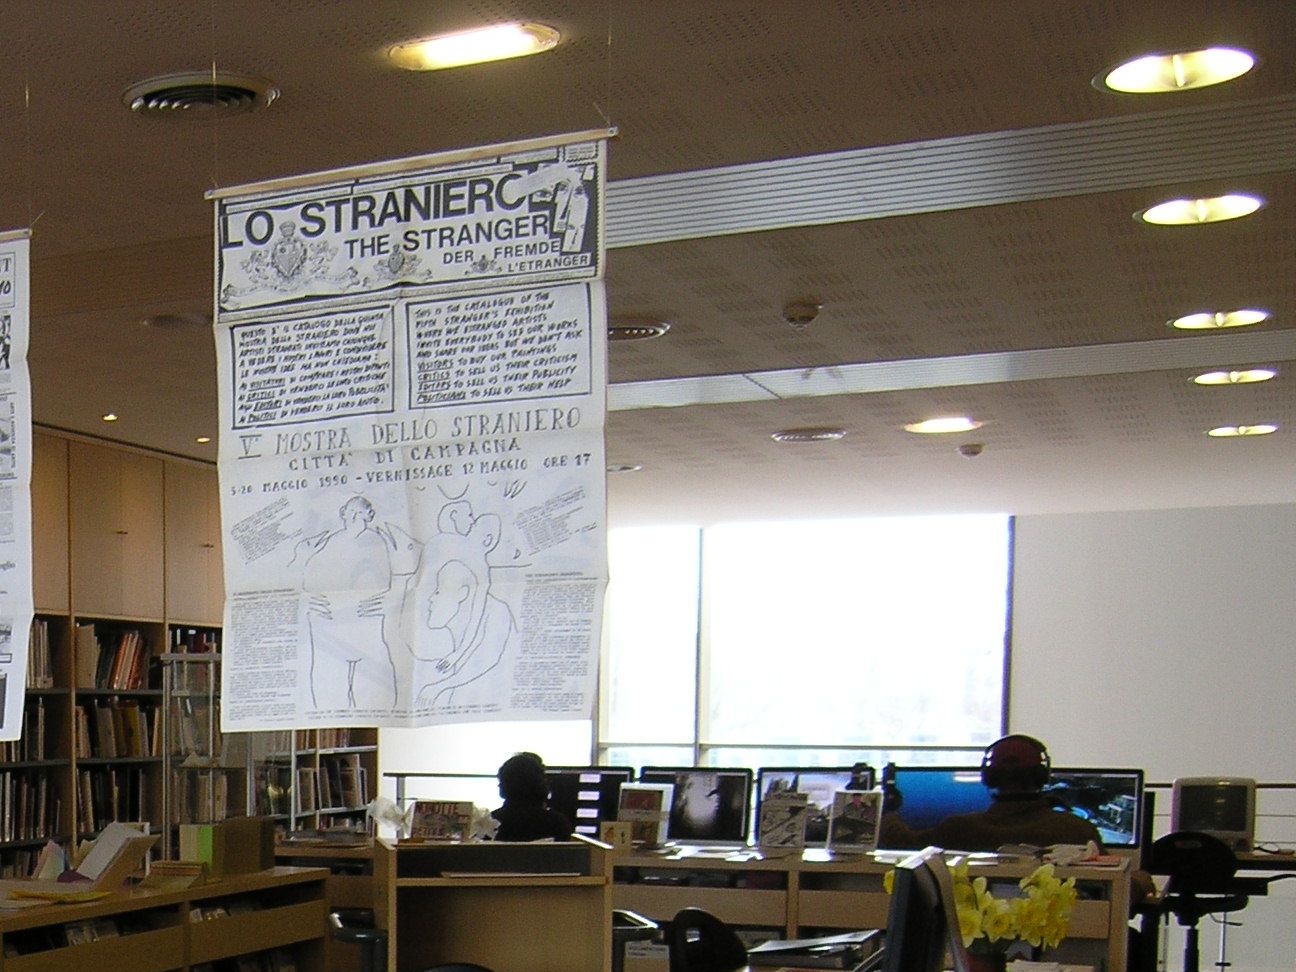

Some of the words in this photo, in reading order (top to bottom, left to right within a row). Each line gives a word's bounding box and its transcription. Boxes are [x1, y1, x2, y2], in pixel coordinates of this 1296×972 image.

[220, 211, 274, 249] LO
[344, 234, 390, 259] THE
[403, 213, 549, 251] STRANGER
[443, 250, 474, 265] DER
[494, 240, 561, 259] FREMDE
[508, 255, 588, 273] L'ETRANGER
[275, 428, 352, 455] MOSTRA
[372, 419, 438, 445] DELLO
[452, 407, 582, 437] STRANIERO
[376, 450, 395, 464] DI
[411, 438, 522, 461] CAMPAGNA
[263, 479, 308, 492] MAGGIO
[319, 474, 348, 488] 1990
[366, 464, 453, 483] VERNISSAGE
[463, 462, 474, 475] 12
[480, 458, 528, 473] MAGGIO
[544, 455, 567, 468] ORE
[574, 453, 592, 466] 17
